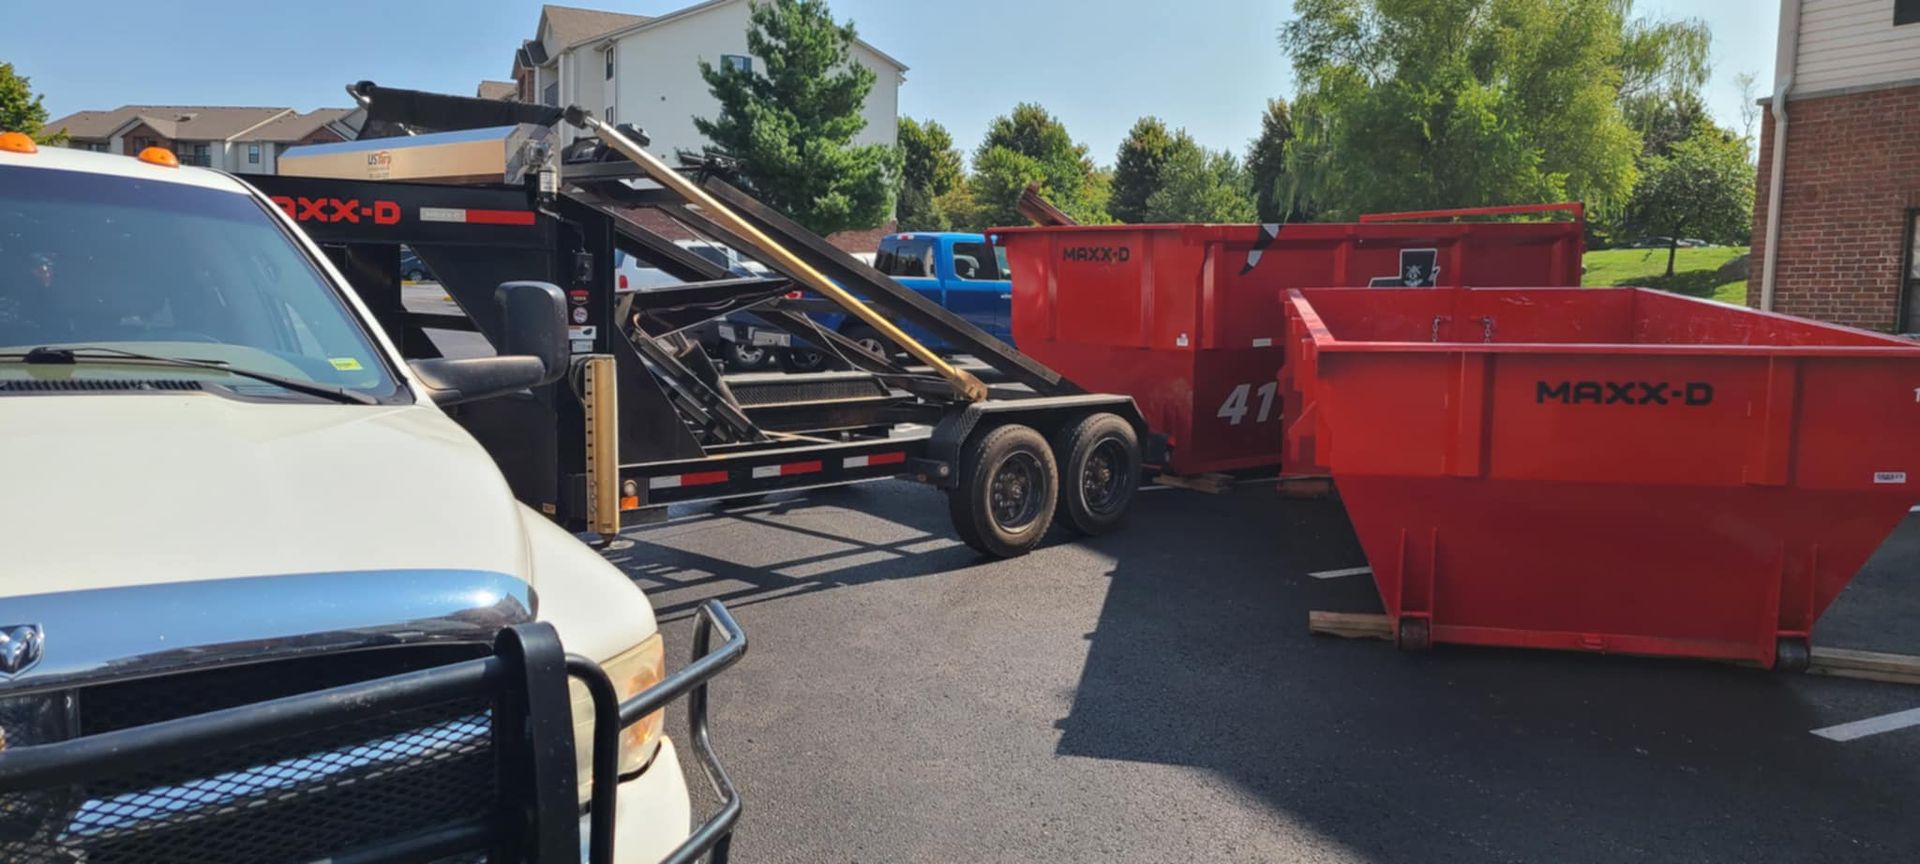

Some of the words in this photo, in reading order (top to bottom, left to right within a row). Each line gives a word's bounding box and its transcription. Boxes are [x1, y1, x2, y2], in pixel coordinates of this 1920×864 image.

[269, 196, 401, 225] AXX-D
[1063, 247, 1130, 262] MAXX-D
[1217, 381, 1284, 425] 41
[1537, 381, 1713, 406] MAXX-D
